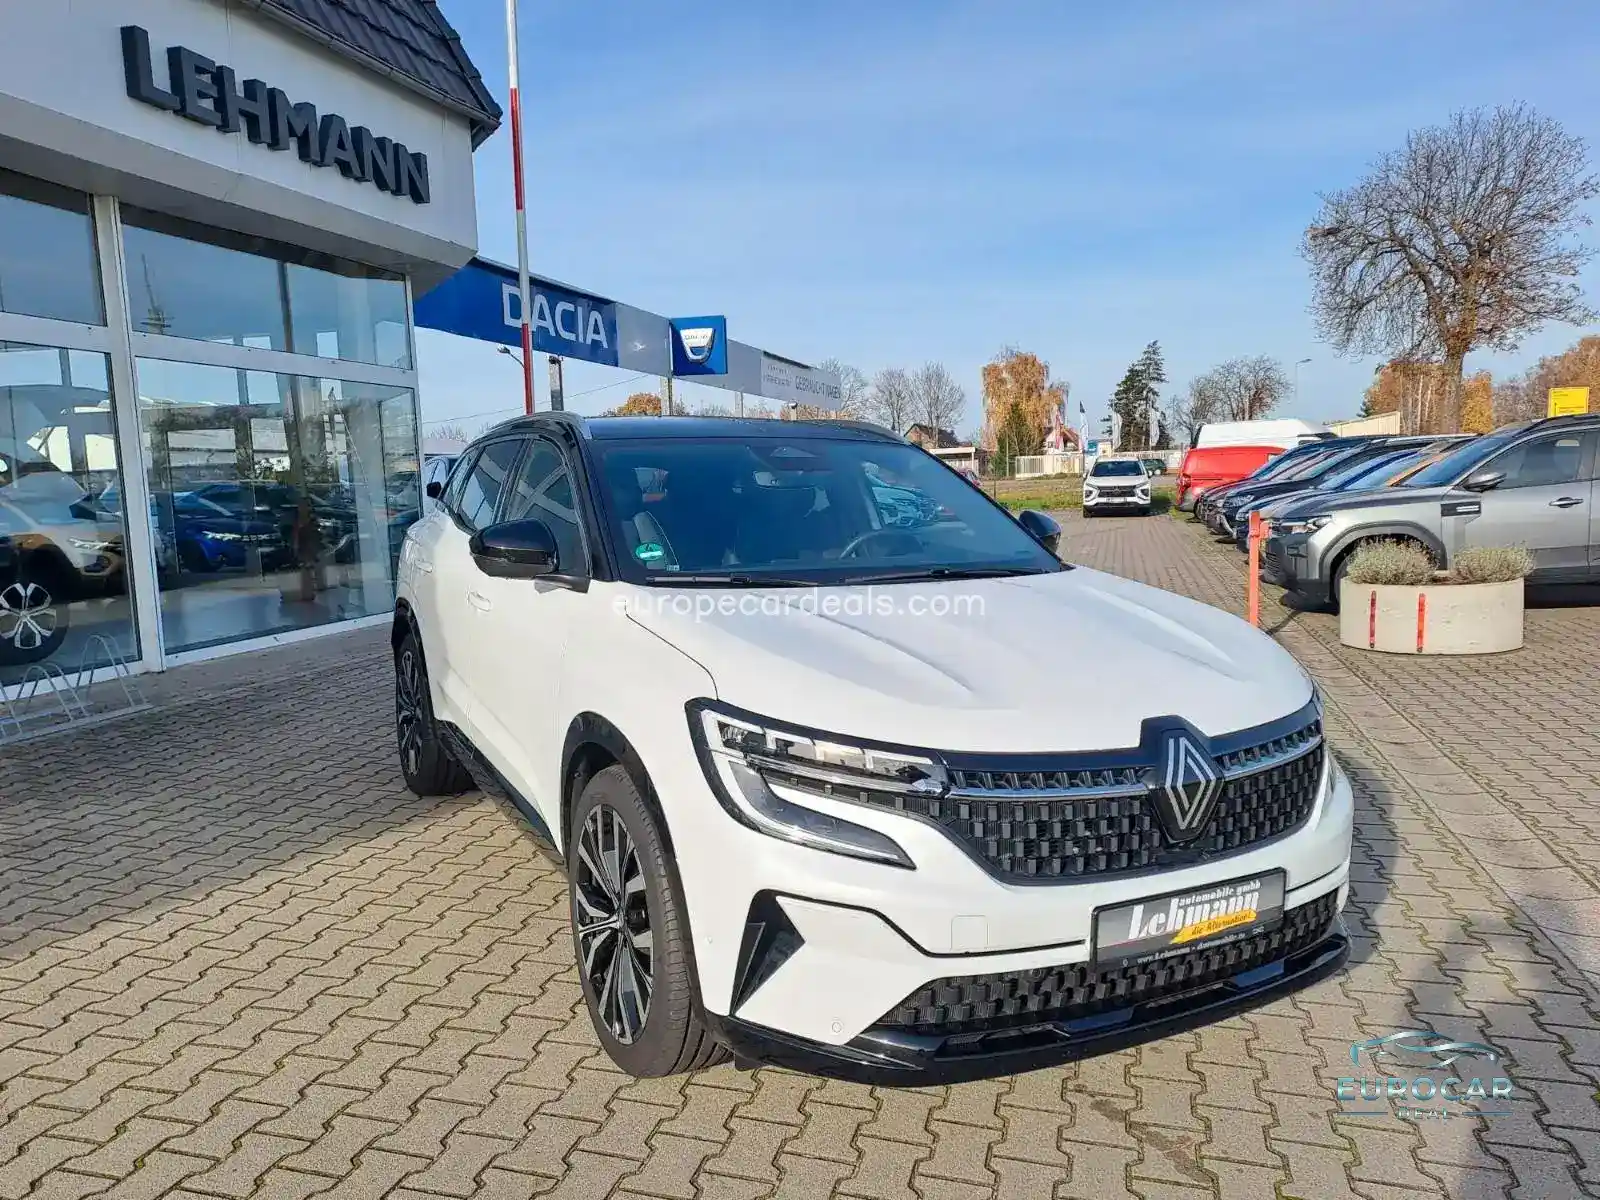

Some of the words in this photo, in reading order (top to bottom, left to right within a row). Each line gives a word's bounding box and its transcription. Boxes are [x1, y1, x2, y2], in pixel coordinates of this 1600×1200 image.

[120, 25, 431, 204] LEHMANN
[502, 282, 609, 349] DACIA
[1128, 891, 1260, 940] Lehmann
[1178, 886, 1234, 906] automobile
